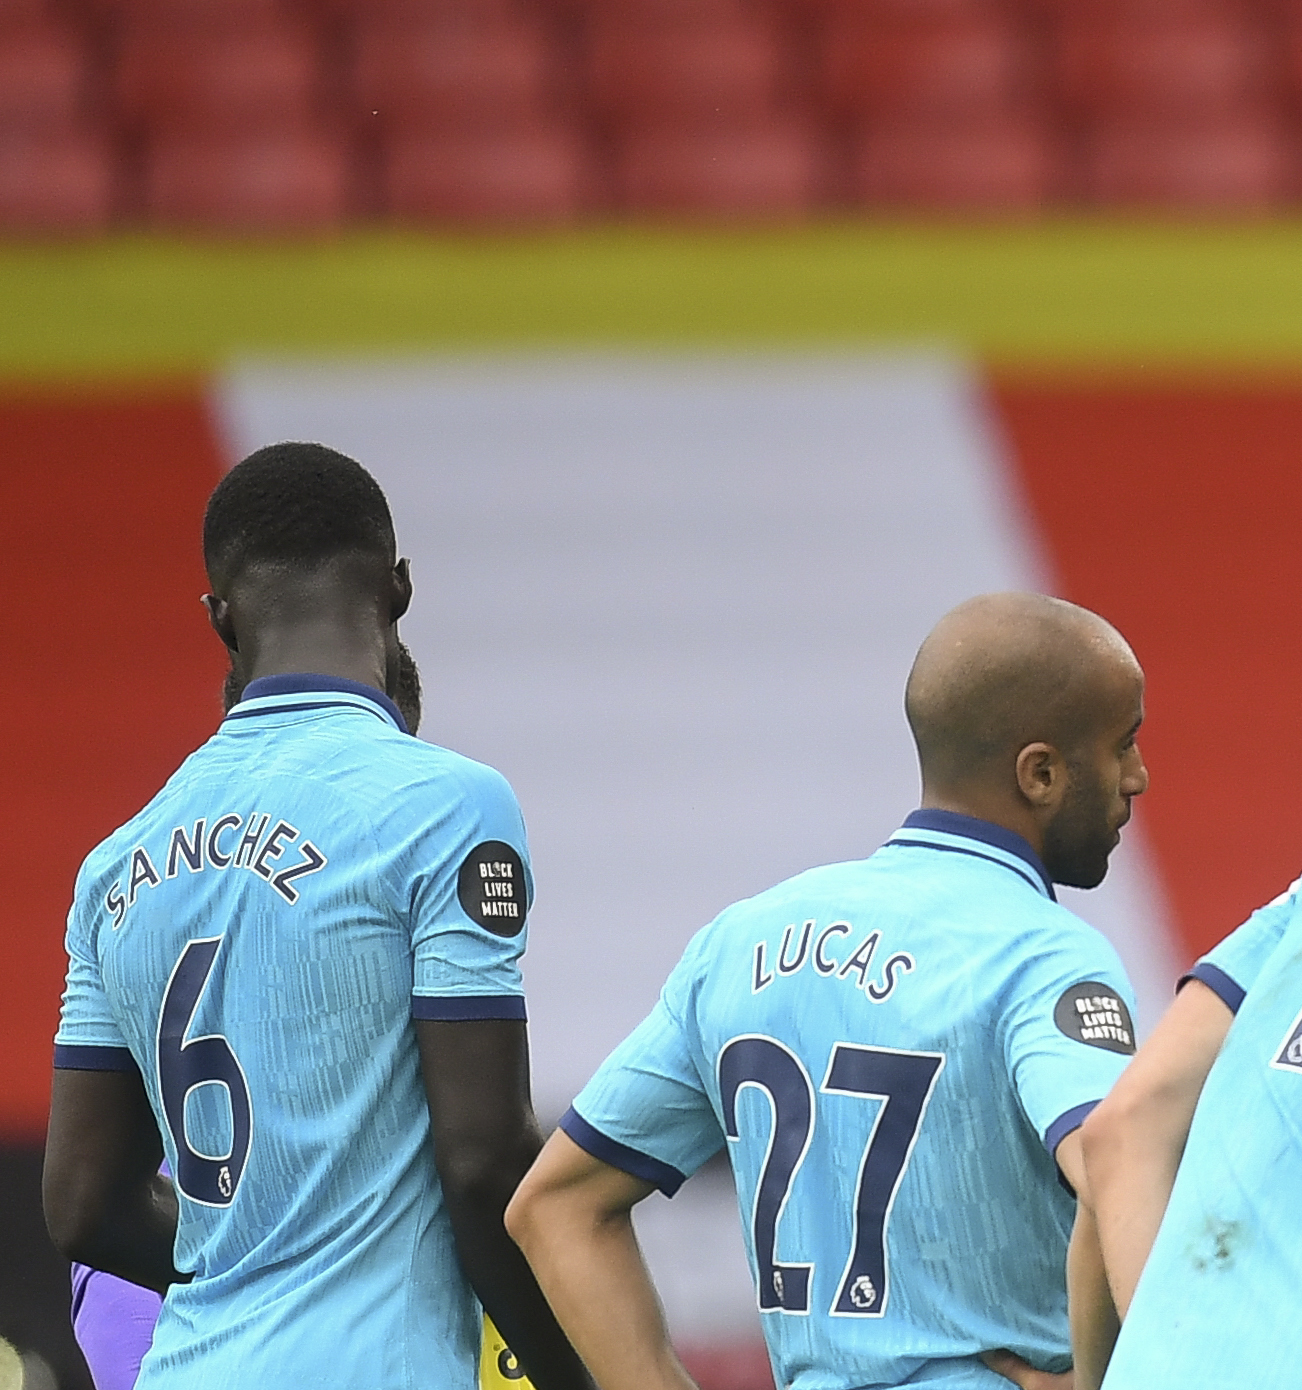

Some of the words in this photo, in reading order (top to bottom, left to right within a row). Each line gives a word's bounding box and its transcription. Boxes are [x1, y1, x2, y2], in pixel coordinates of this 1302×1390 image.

[104, 812, 327, 930] SANCHEZ
[484, 882, 514, 898] LIVES
[481, 901, 519, 918] MATTER
[751, 918, 917, 1004] LUCAS
[1081, 1025, 1132, 1046] MATTER
[1082, 1011, 1122, 1028] LIVES
[155, 935, 254, 1209] 6
[717, 1033, 947, 1319] 27
